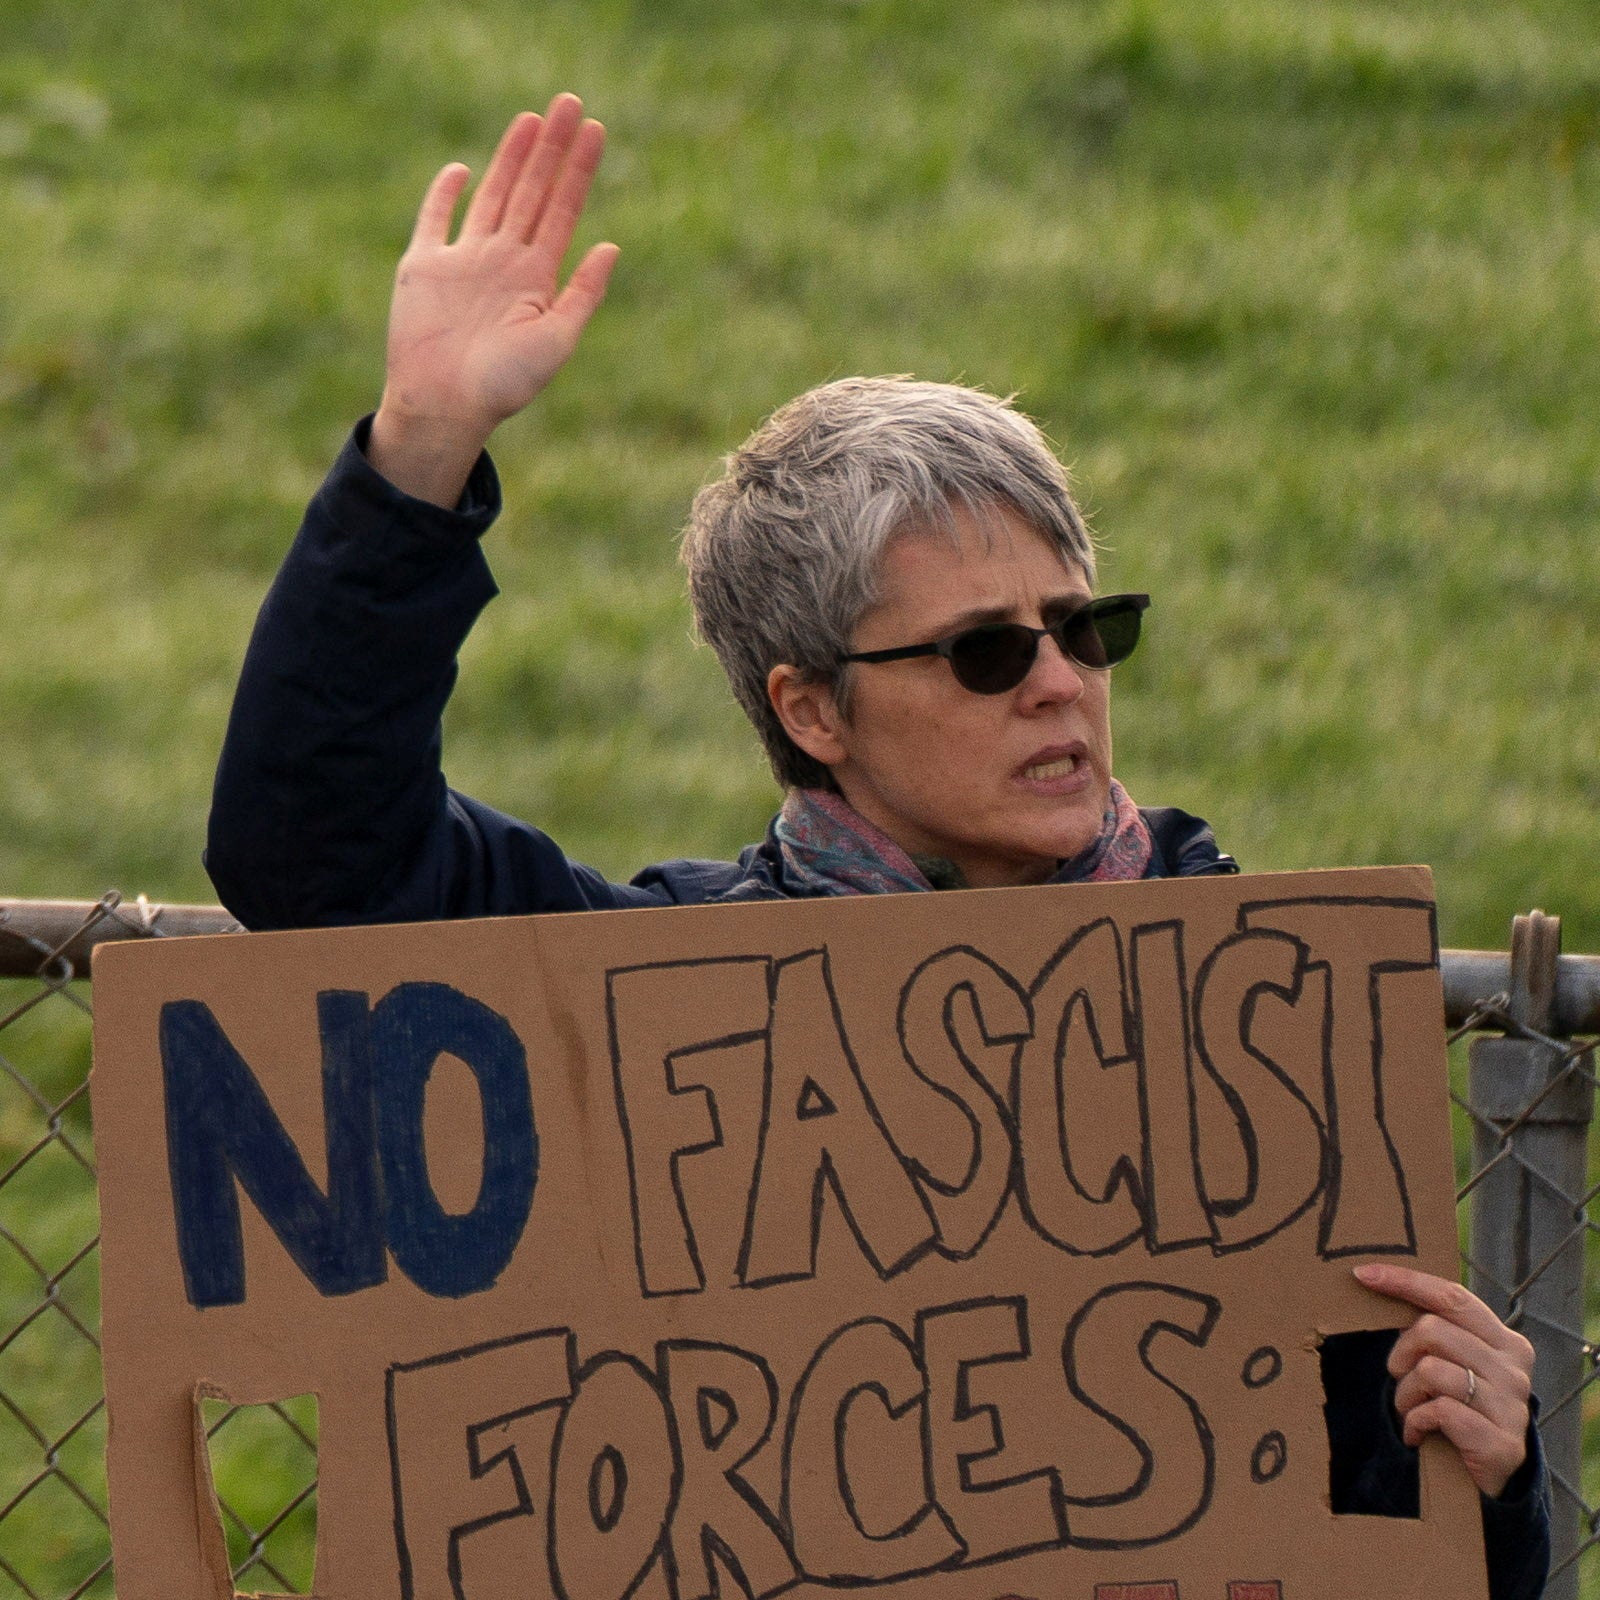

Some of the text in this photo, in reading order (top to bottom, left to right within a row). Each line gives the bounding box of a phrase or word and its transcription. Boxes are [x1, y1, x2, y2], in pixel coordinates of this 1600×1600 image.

[158, 896, 1438, 1309] NO FASCIST
[387, 1282, 1287, 1600] FORCES:
